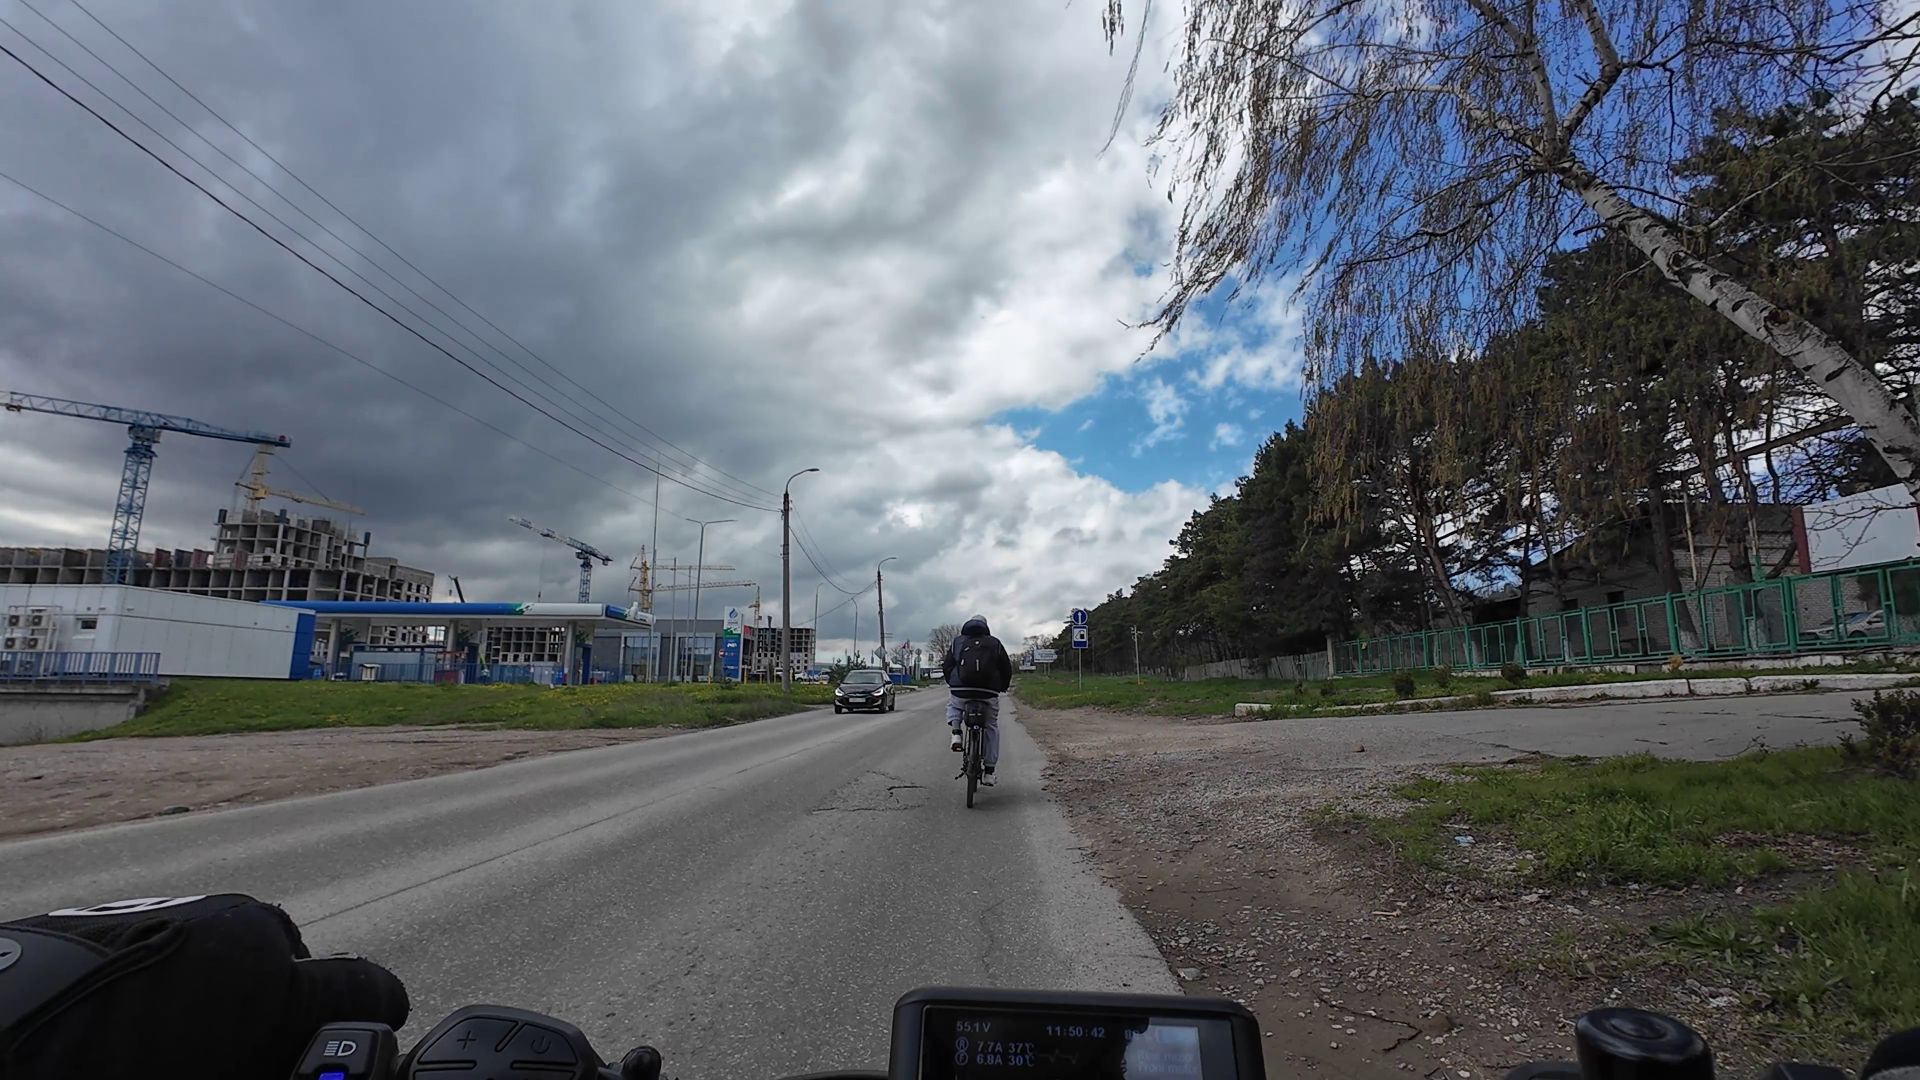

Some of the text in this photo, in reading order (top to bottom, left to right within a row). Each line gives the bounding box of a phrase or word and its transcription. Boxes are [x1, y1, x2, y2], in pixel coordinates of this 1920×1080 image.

[1046, 1025, 1105, 1038] 11:50:42
[976, 1040, 1003, 1053] 7.7A
[976, 1054, 1003, 1065] 6.8A
